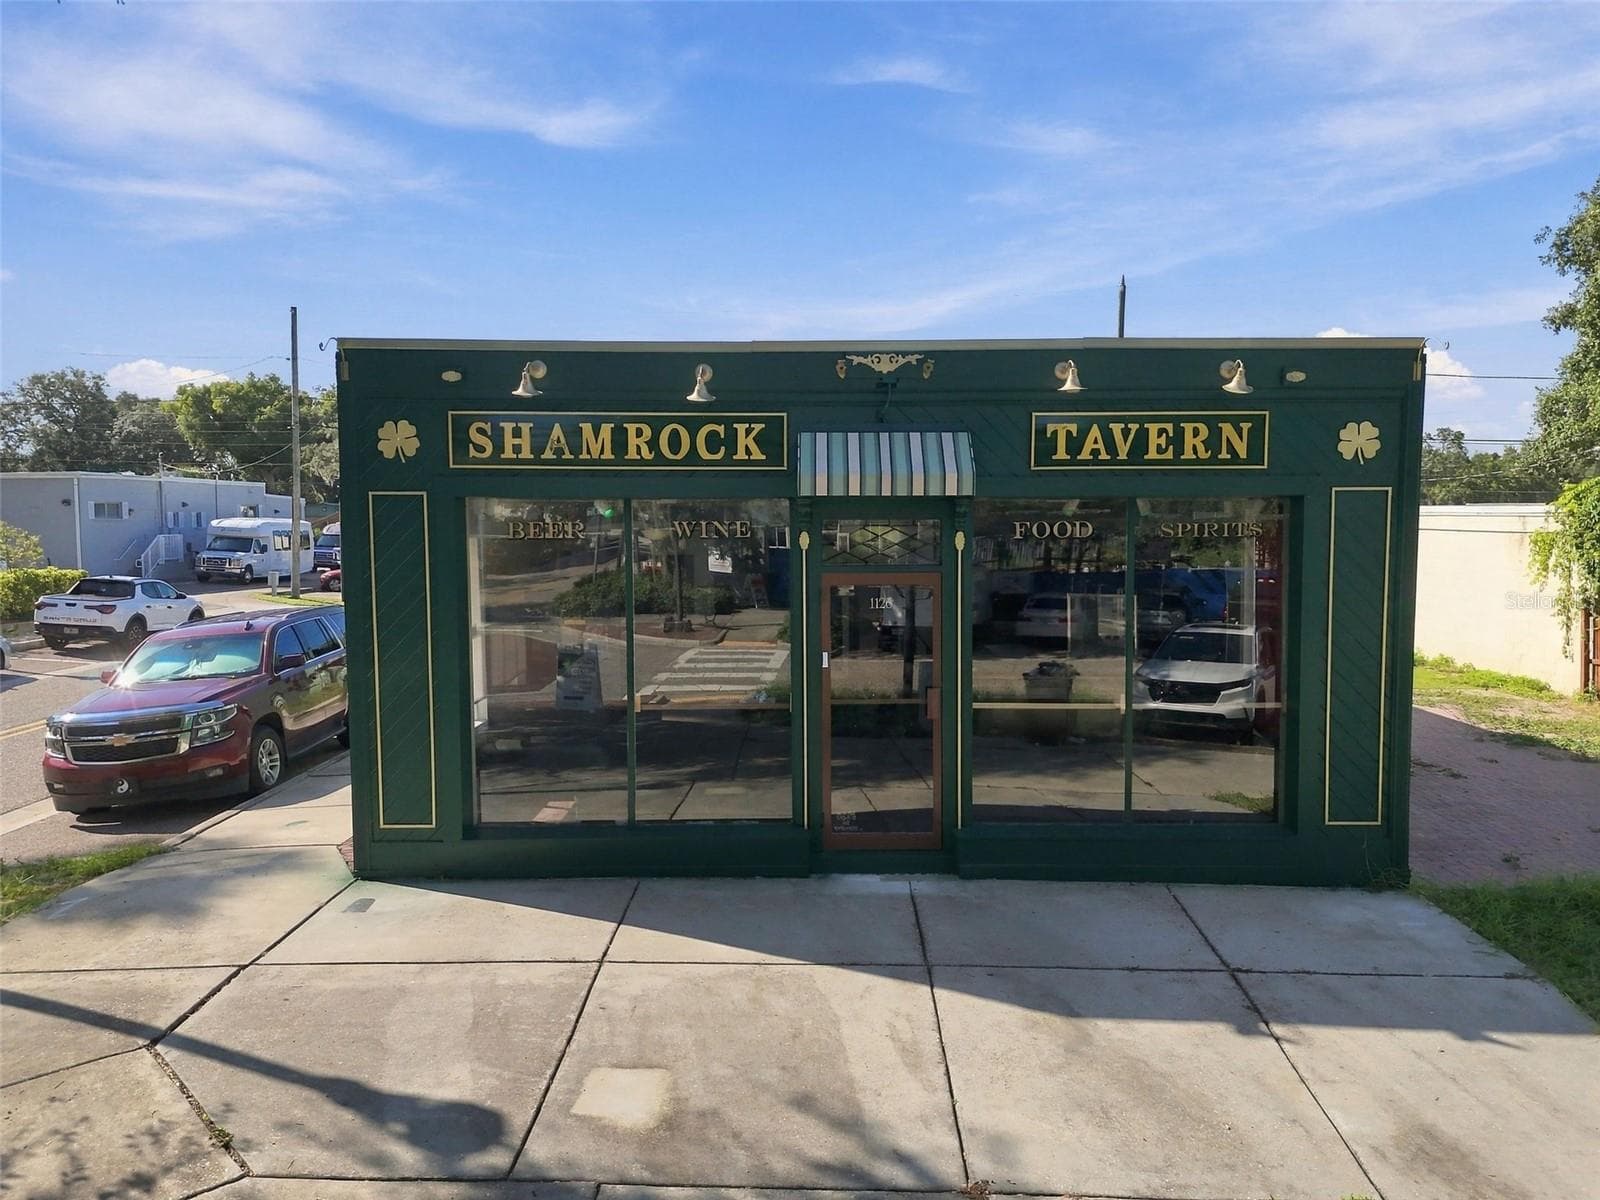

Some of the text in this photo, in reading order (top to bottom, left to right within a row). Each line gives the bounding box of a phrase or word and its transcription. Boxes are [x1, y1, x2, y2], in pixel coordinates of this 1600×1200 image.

[468, 421, 767, 461] SHAMROCK
[1046, 423, 1253, 460] TAVERN
[507, 520, 585, 539] BEER
[672, 519, 751, 539] WINE
[1013, 520, 1094, 540] FOOD
[1160, 522, 1263, 538] SPIRITS
[869, 597, 894, 609] 1126
